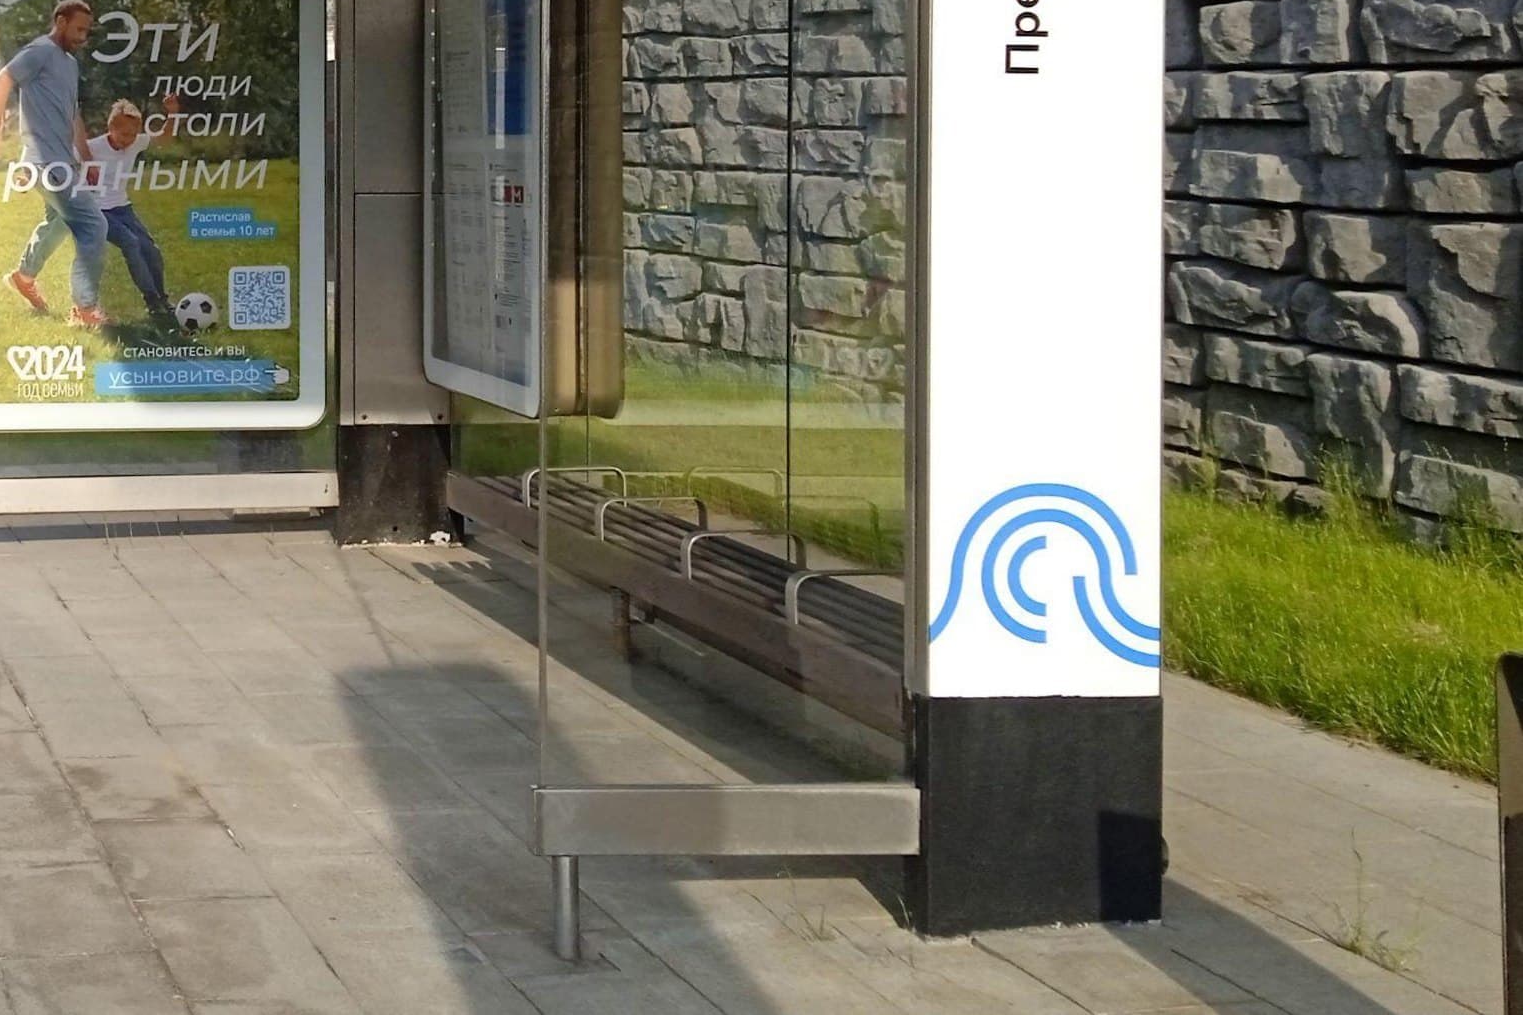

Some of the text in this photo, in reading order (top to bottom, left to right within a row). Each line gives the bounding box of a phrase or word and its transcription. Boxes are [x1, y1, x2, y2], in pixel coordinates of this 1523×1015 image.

[91, 10, 221, 64] Эти
[149, 75, 252, 101] люди
[144, 112, 266, 137] стали
[1, 158, 268, 203] родными
[191, 211, 251, 223] Растислав
[191, 225, 275, 237] в семье 10 лет
[23, 345, 86, 380] 2024
[123, 345, 246, 359] СТАНОВИТЕСЬ И ВЫ
[109, 364, 261, 386] усыновите.рф
